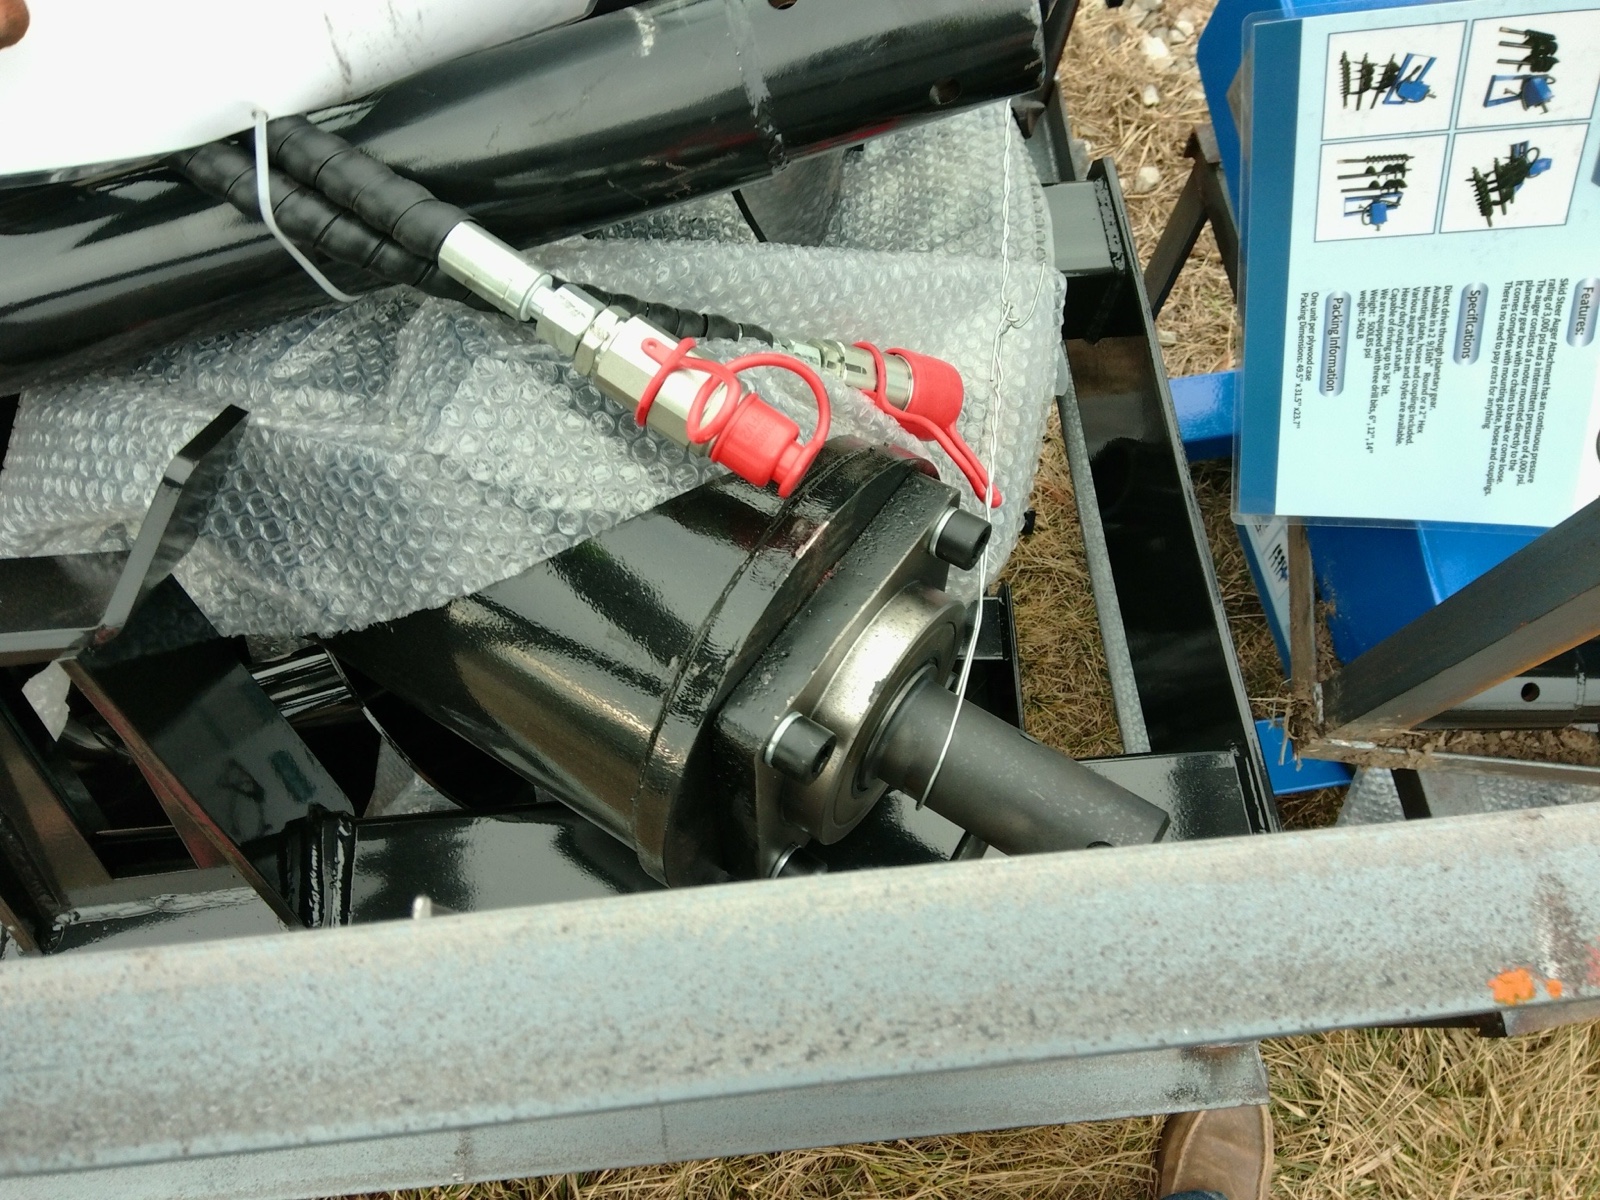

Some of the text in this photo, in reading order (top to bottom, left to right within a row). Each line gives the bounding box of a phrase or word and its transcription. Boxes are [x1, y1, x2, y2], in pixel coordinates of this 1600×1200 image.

[1502, 281, 1513, 303] There
[1536, 279, 1546, 294] The
[1543, 279, 1556, 302] rating
[1558, 278, 1569, 295] Skid
[1297, 293, 1309, 321] Packing
[1310, 292, 1319, 306] One
[1389, 288, 1400, 317] Capable
[1410, 286, 1421, 314] Various
[1430, 286, 1442, 319] Available
[1511, 287, 1521, 312] comes
[1519, 280, 1535, 316] planetary
[1531, 295, 1542, 317] auger
[1554, 296, 1565, 317] Steer
[1309, 307, 1318, 322] unit
[1356, 290, 1369, 339] weight: 540LB
[1540, 312, 1552, 332] 3,000
[1575, 287, 1594, 336] Features:
[1306, 323, 1315, 334] per
[1363, 289, 1378, 358] Weight: 500LBS psi
[1375, 314, 1385, 347] equipped
[1393, 288, 1410, 373] Heavy duty output shaft.
[1406, 315, 1416, 335] auger
[1496, 322, 1505, 341] need
[1505, 312, 1520, 348] complete
[1518, 317, 1527, 334] gear
[1527, 318, 1538, 348] consists
[1549, 318, 1561, 340] Auger
[1297, 321, 1309, 363] Dimensions:
[1326, 297, 1344, 391] Packing Information
[1383, 326, 1396, 352] driving
[1406, 336, 1416, 346] bit
[1429, 285, 1453, 410] Direct drive through planetary gear.
[1516, 335, 1526, 349] box
[1538, 333, 1547, 345] psi
[1305, 335, 1316, 365] plywood
[1374, 347, 1385, 364] with
[1404, 347, 1414, 365] sizes
[1491, 351, 1500, 365] pay
[1503, 349, 1513, 366] with
[1514, 350, 1523, 367] with
[1536, 346, 1545, 360] and
[1403, 365, 1411, 379] and
[1406, 286, 1431, 445] Mounting plate, hoses and couplings included.
[1543, 341, 1557, 386] Attachment
[1372, 365, 1381, 384] three
[1421, 372, 1431, 395] Round
[1490, 366, 1498, 385] extra
[1496, 367, 1509, 403] mounting
[1521, 364, 1530, 387] motor
[1371, 384, 1379, 398] drill
[1381, 385, 1390, 396] bit.
[1400, 380, 1410, 400] styles
[1488, 386, 1498, 396] for
[1508, 379, 1519, 403] chains
[1528, 367, 1543, 412] intermittent
[1541, 387, 1551, 400] has
[1368, 399, 1378, 414] bits,
[1481, 397, 1497, 429] anything
[1493, 404, 1505, 424] plate,
[1516, 388, 1527, 422] mounted
[1396, 413, 1405, 446] available.
[1417, 420, 1425, 433] Hex
[1504, 413, 1515, 433] break
[1523, 413, 1534, 445] pressure
[1532, 411, 1544, 452] continuous
[1492, 425, 1502, 446] hoses
[1510, 422, 1523, 450] directly
[1490, 447, 1498, 460] and
[1499, 443, 1508, 463] come
[1518, 454, 1529, 473] 4,000
[1496, 464, 1507, 484] loose.
[1508, 459, 1518, 471] the
[1527, 453, 1538, 483] pressure
[1483, 461, 1495, 496] couplings.
[1516, 474, 1525, 486] psi.
